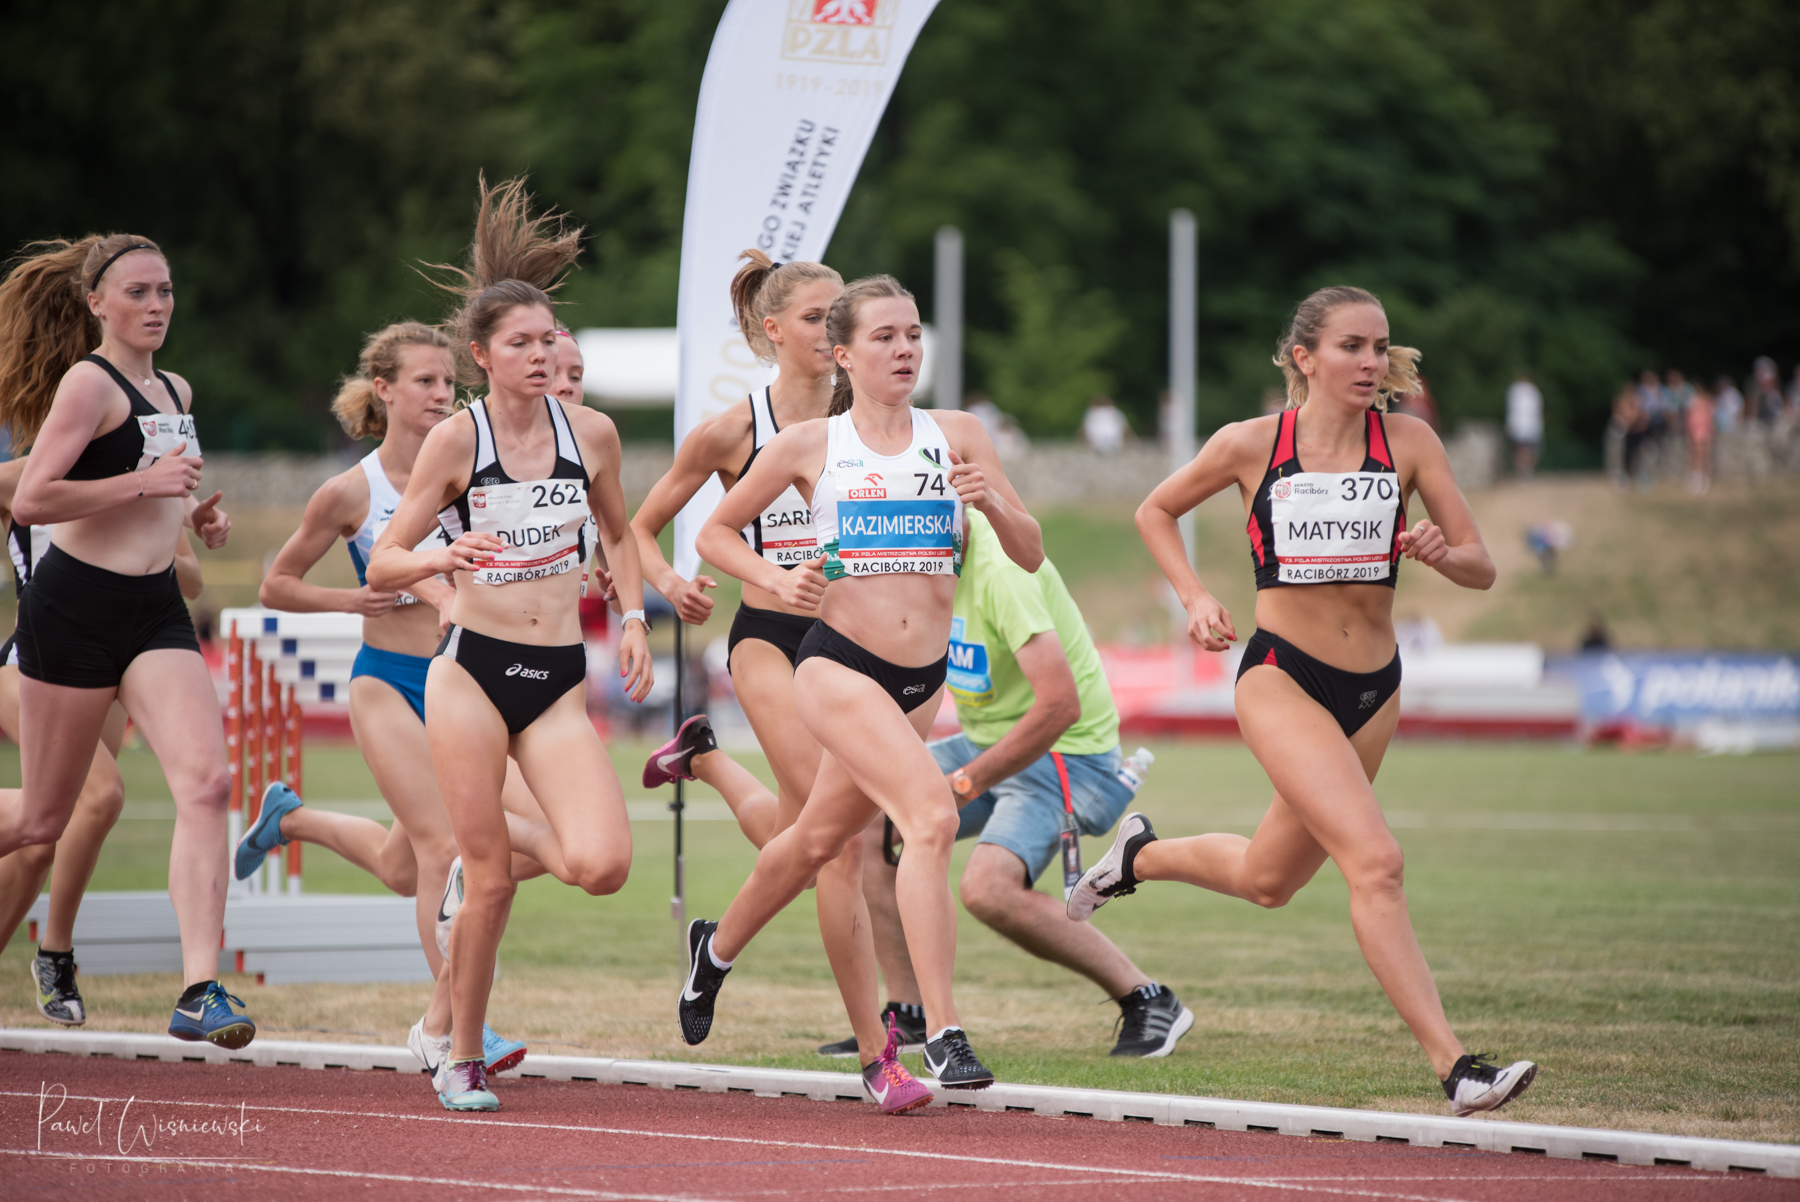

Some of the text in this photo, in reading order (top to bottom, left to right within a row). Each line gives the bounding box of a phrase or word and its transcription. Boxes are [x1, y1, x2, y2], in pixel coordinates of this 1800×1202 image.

[788, 26, 881, 60] PZLA
[797, 126, 841, 216] ATLETYKI
[757, 215, 782, 254] GO
[531, 483, 582, 508] 262
[850, 489, 884, 498] ORLEN
[914, 473, 946, 496] 74
[1294, 487, 1329, 495] Racibórz
[1341, 477, 1394, 501] 370
[496, 524, 565, 547] DUDEK
[842, 515, 952, 536] KAZIMIERSKA
[1288, 520, 1383, 540] MATYSIK
[486, 560, 569, 583] RACIBÓRZ 2019
[510, 558, 548, 567] MISTRZOSTWA
[853, 559, 944, 573] RACIBÓRZ 2019
[1287, 565, 1380, 580] RACIBÓRZ 2019
